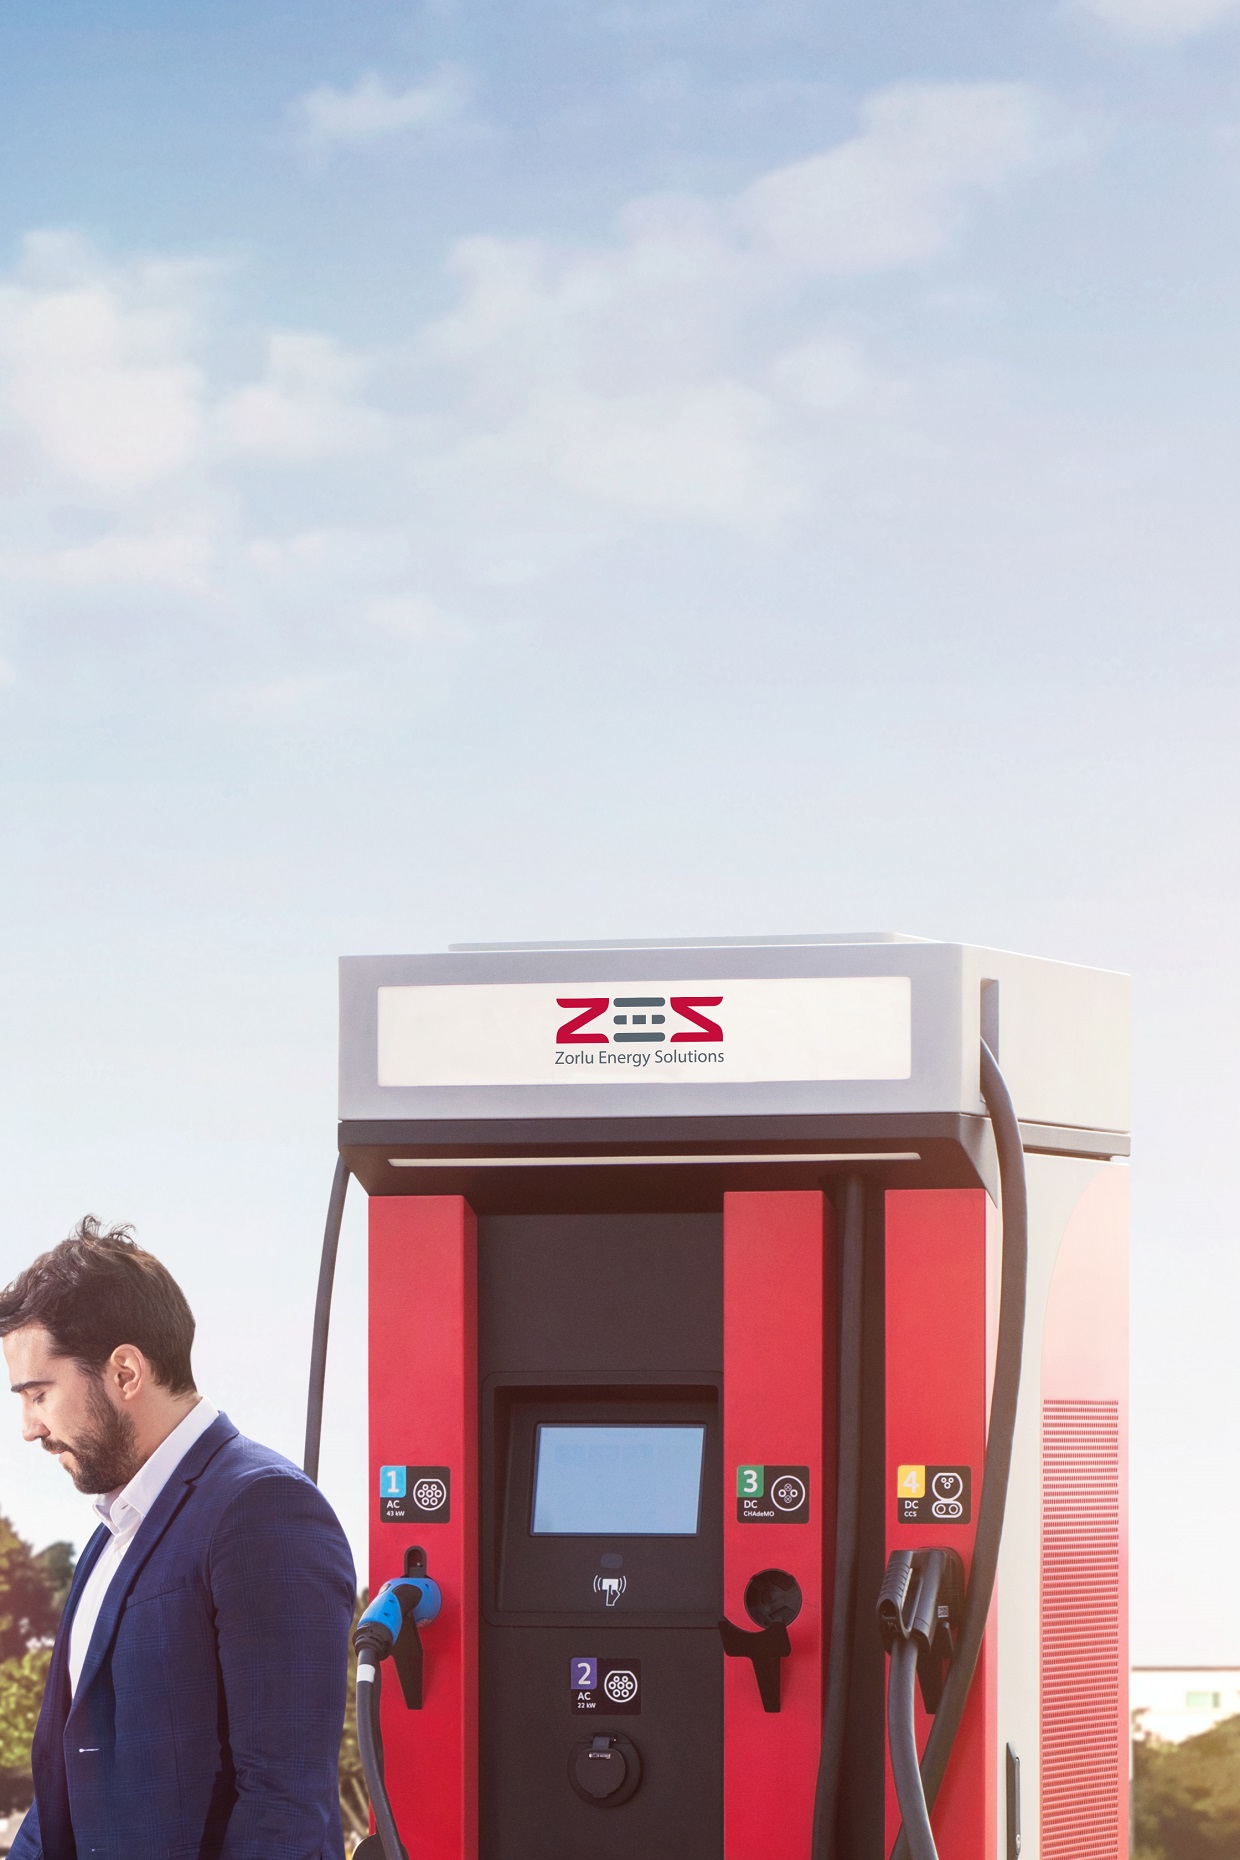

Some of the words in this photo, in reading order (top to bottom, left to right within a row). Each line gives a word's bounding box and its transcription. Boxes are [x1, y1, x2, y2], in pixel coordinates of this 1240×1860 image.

[555, 995, 724, 1045] ZES
[555, 1051, 594, 1065] Zorlu
[599, 1051, 651, 1068] Energy
[655, 1049, 725, 1064] Solutions
[387, 1470, 400, 1493] 1
[743, 1469, 758, 1493] 3
[902, 1470, 920, 1494] 4
[386, 1500, 400, 1509] AC
[743, 1500, 758, 1509] DC
[904, 1500, 919, 1509] DC
[577, 1662, 591, 1685] 2
[577, 1691, 591, 1701] AC
